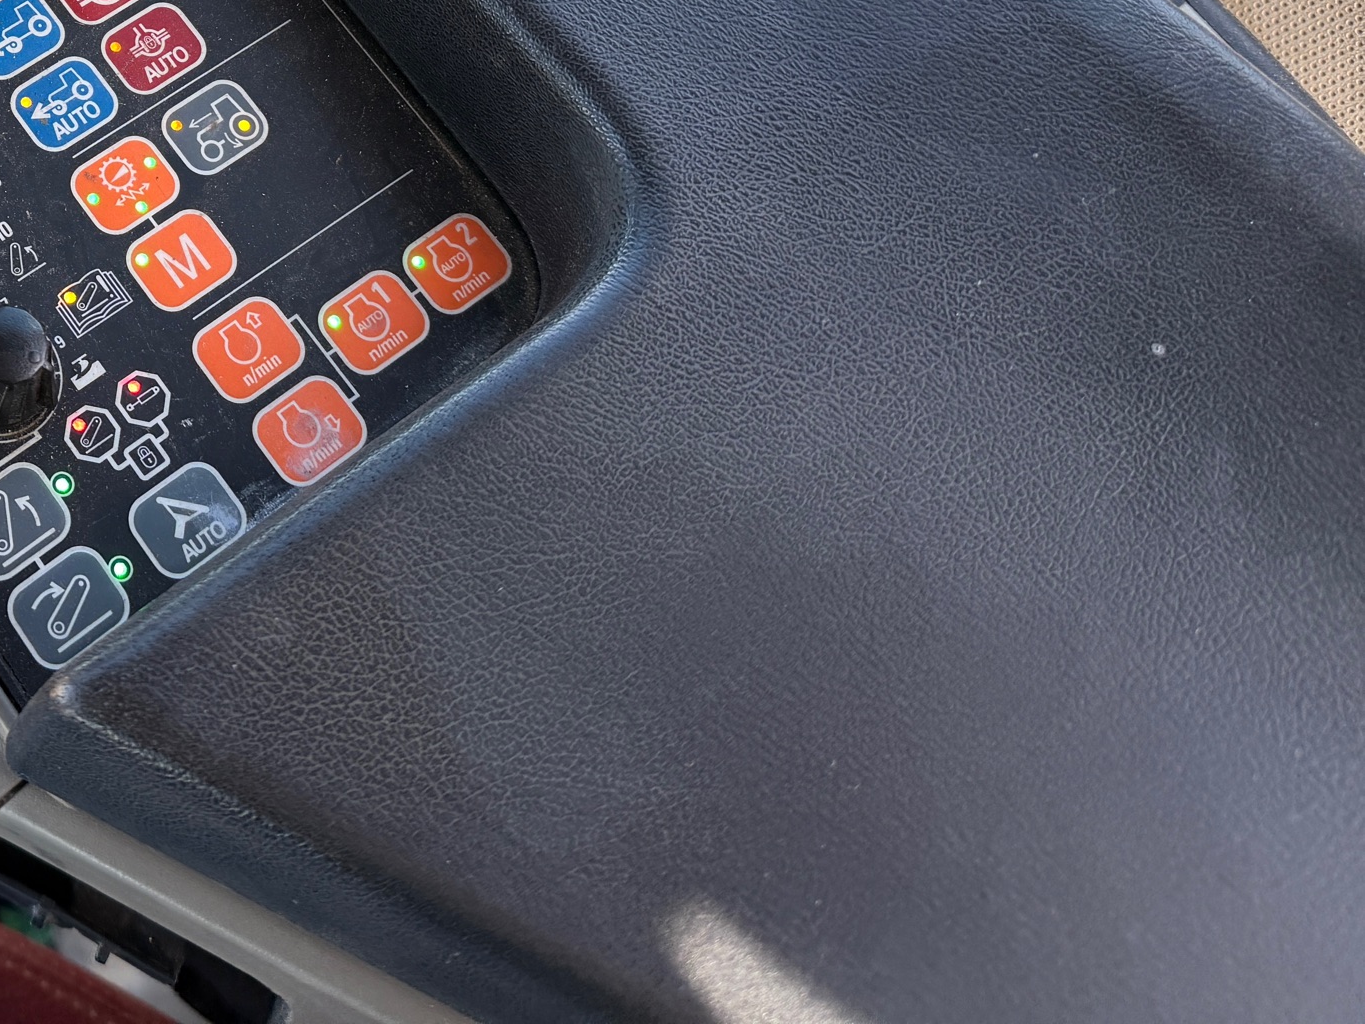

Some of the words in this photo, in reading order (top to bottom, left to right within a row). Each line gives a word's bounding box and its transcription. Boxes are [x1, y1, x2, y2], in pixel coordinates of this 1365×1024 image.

[143, 46, 190, 83] AUTO
[52, 99, 101, 141] AUTO
[455, 222, 477, 246] 2
[154, 232, 212, 289] M
[441, 251, 466, 274] AUTO
[372, 282, 391, 303] 1
[452, 269, 491, 302] n/min
[358, 310, 384, 333] AUTO
[54, 335, 66, 349] 9
[368, 328, 409, 363] n/min
[242, 352, 283, 387] n/min
[302, 438, 343, 472] n/min
[181, 520, 228, 564] AUTO
